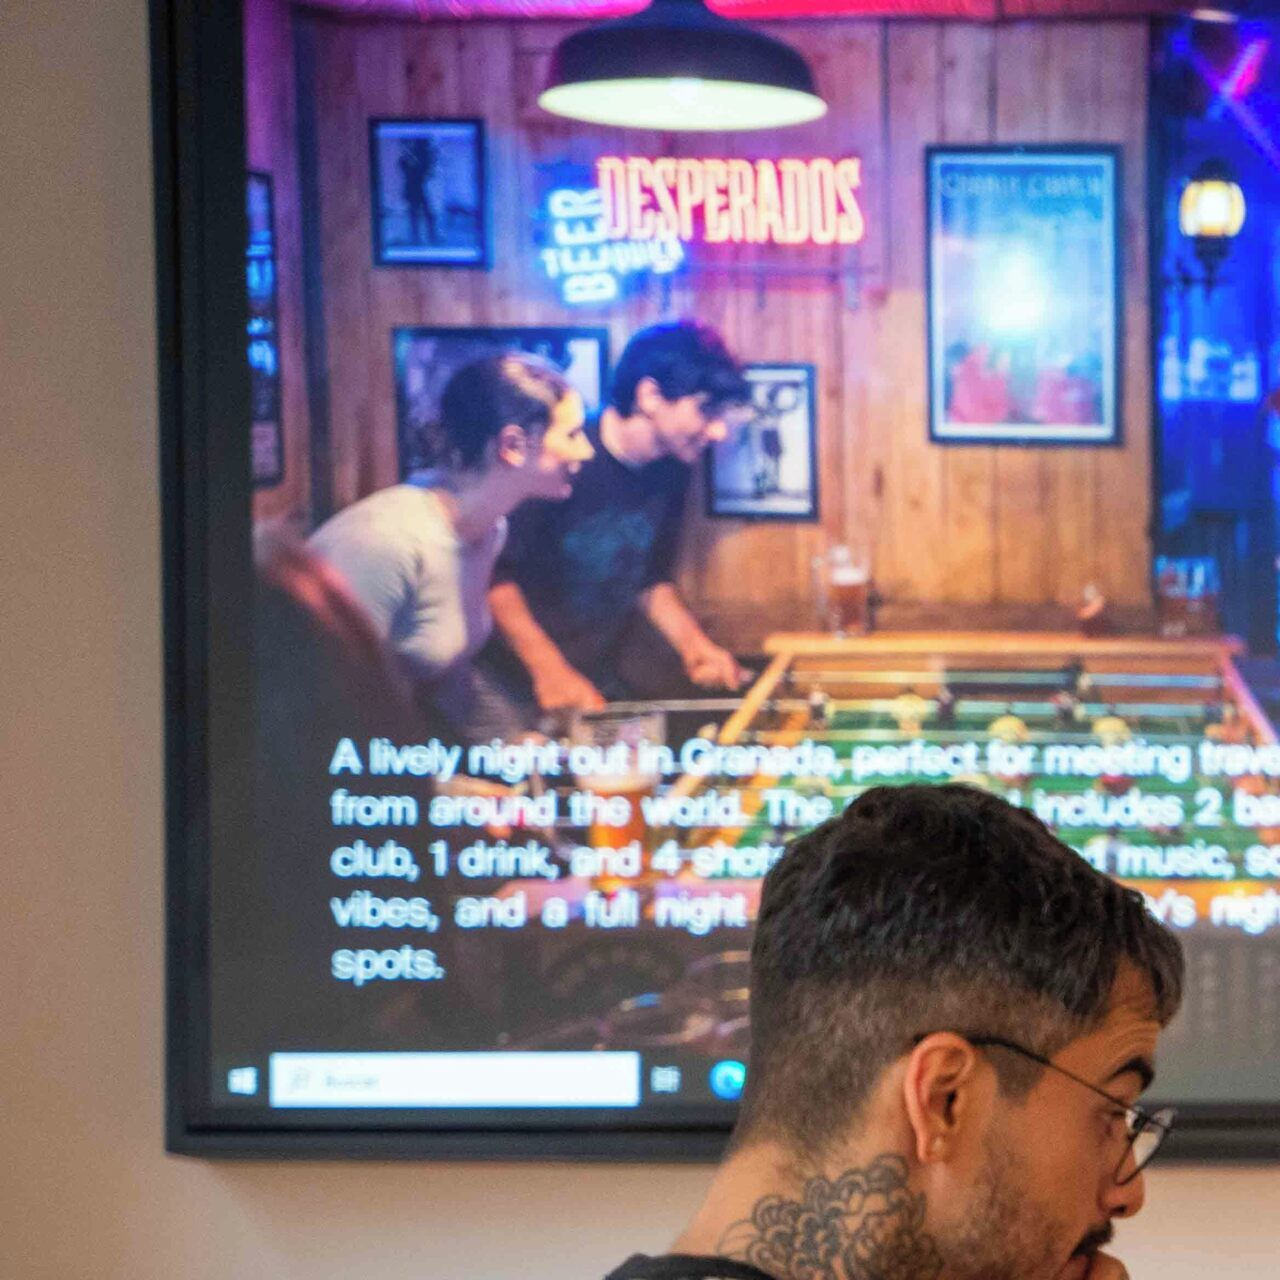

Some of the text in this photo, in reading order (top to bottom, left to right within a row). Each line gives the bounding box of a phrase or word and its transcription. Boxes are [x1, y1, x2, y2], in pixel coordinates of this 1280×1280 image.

[597, 157, 865, 244] DESPERADOS
[329, 737, 362, 775] A
[369, 737, 462, 782] lively
[468, 737, 561, 783] night
[568, 740, 632, 776] out
[637, 738, 675, 776] in
[681, 737, 844, 780] Granada,
[851, 738, 980, 783] perfect
[986, 738, 1038, 776] for
[1043, 738, 1192, 784] meeting
[329, 788, 418, 827] from
[429, 790, 558, 827] around
[568, 790, 632, 827] the
[640, 789, 746, 827] world.
[762, 789, 834, 826] The
[1032, 787, 1186, 827] includes
[1193, 786, 1224, 827] 2
[330, 839, 420, 882] club,
[428, 840, 449, 877] 1
[458, 839, 560, 880] drink,
[570, 840, 642, 877] and
[651, 839, 682, 876] 4
[1116, 838, 1236, 880] music,
[330, 889, 440, 932] vibes,
[453, 891, 527, 928] and
[541, 897, 569, 928] a
[584, 890, 641, 928] full
[654, 891, 748, 936] night
[330, 944, 446, 987] spots.
